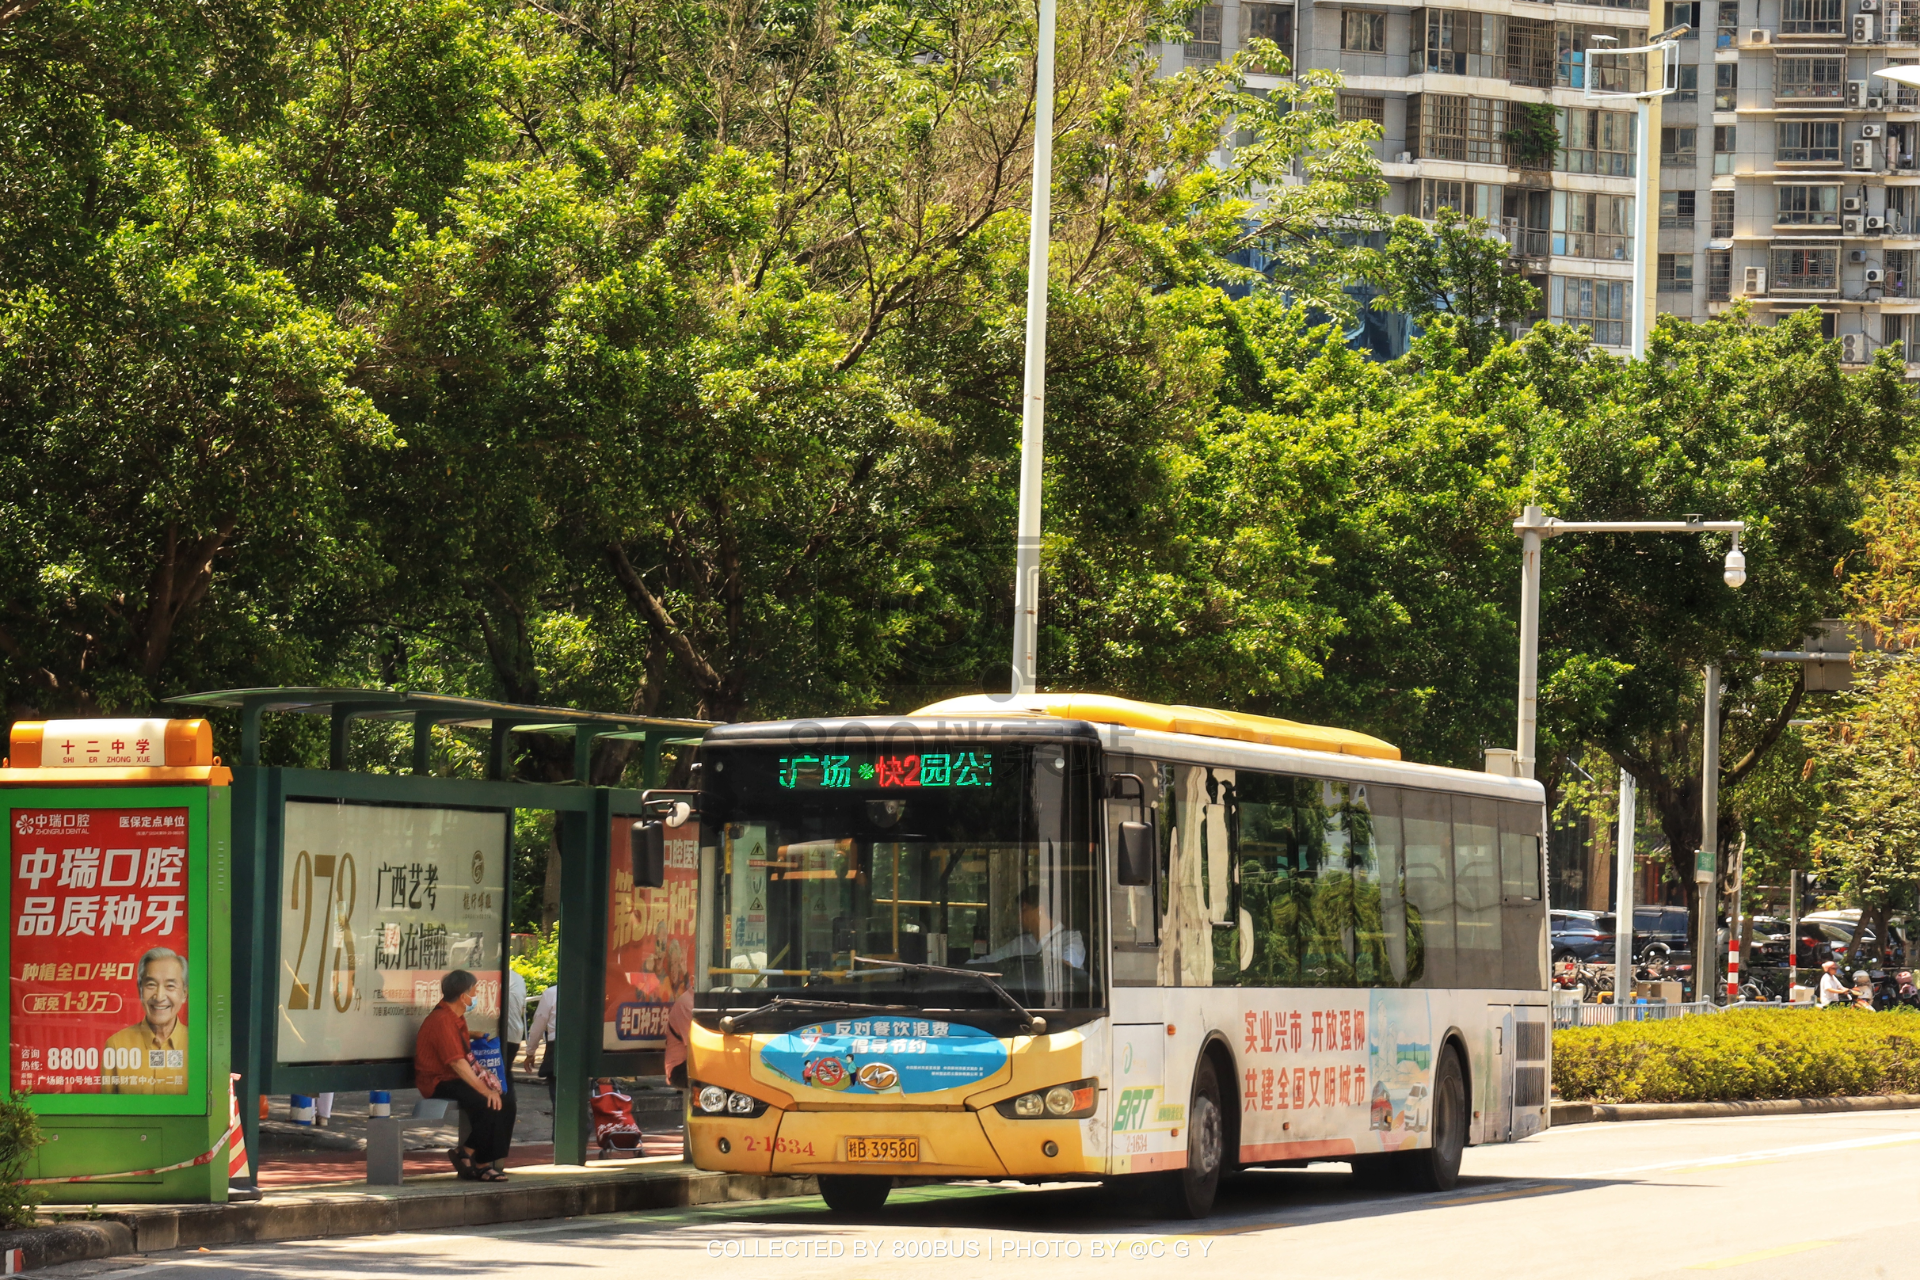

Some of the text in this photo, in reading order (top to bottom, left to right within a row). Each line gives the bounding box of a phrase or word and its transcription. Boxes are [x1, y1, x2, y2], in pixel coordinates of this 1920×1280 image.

[61, 738, 150, 755] 十二中学
[62, 756, 75, 764] SHI
[88, 756, 98, 764] ER
[136, 755, 151, 763] XUE
[35, 814, 90, 828] 中瑞口腔
[119, 815, 185, 828] 医保定点单位
[18, 846, 186, 890] 中瑞口腔
[375, 861, 439, 912] 广西艺考
[17, 894, 186, 937] 品质种牙
[288, 850, 357, 1013] 278
[21, 962, 135, 981] 种植全口/半口
[834, 1021, 949, 1038] 反对餐饮浪费
[1245, 1008, 1366, 1054] 实业兴市 开放强柳
[21, 1049, 40, 1059] 咨询
[850, 1038, 928, 1055] 倡导节约
[47, 1047, 142, 1070] 8800 000
[1245, 1064, 1366, 1113] 共建全国文明城市
[1113, 1088, 1155, 1132] BRT
[744, 1135, 816, 1157] 2-1634
[1126, 1134, 1148, 1153] 2-1634
